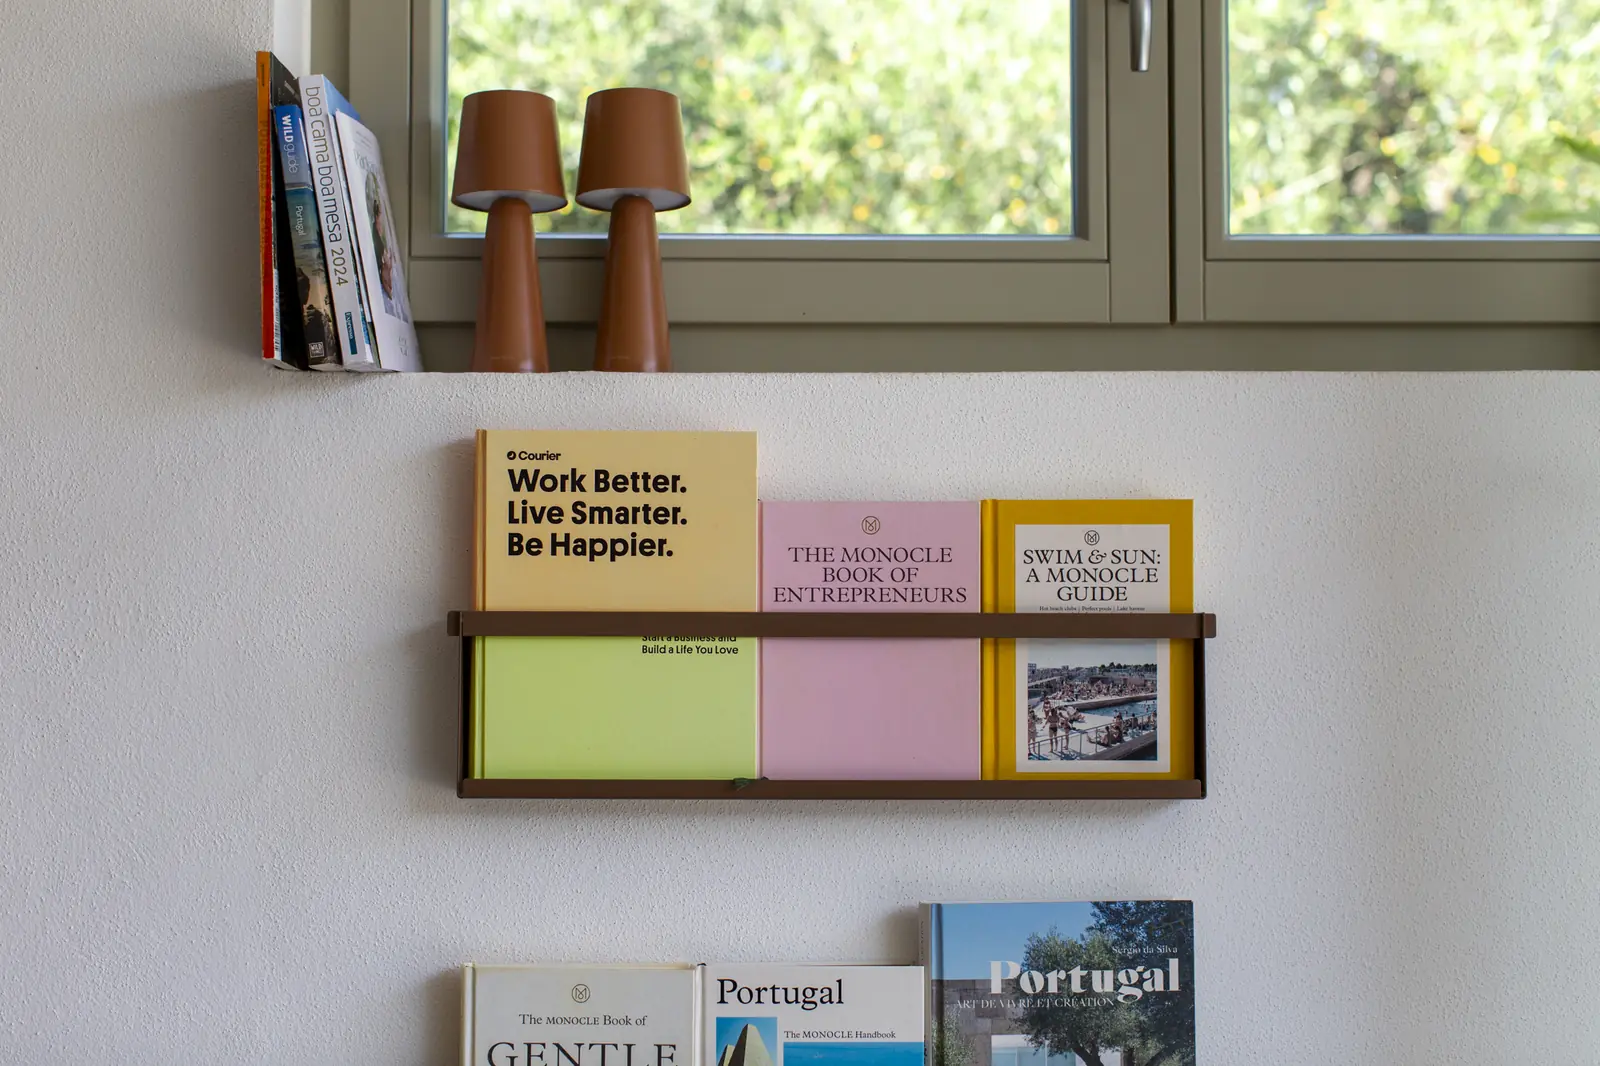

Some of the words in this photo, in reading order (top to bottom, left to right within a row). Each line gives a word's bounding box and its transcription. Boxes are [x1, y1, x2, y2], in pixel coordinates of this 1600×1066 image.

[306, 86, 323, 117] boa
[311, 119, 330, 164] cama
[317, 165, 335, 197] boa
[295, 205, 307, 236] Portugal
[323, 198, 343, 243] mesa
[331, 247, 349, 287] 2024
[518, 451, 561, 461] Courier
[507, 468, 586, 493] Work
[594, 469, 687, 493] Better.
[507, 500, 564, 524] Live
[571, 501, 687, 525] Smarter.
[507, 533, 543, 556] Be
[550, 532, 673, 562] Happier.
[788, 547, 835, 563] THE
[840, 547, 953, 563] MONOCLE
[1023, 549, 1084, 565] SWIM
[1088, 549, 1107, 565] &
[1110, 549, 1161, 565] SUN:
[822, 567, 884, 583] BOOK
[890, 567, 919, 583] OF
[1026, 567, 1040, 583] A
[1046, 567, 1158, 583] MONOCLE
[773, 587, 967, 603] ENTREPRENEURS
[1057, 586, 1128, 601] GUIDE
[642, 645, 667, 654] Build
[676, 645, 693, 654] Life
[695, 645, 713, 654] You
[715, 645, 739, 654] Love
[1112, 945, 1140, 959] Sergio
[1143, 946, 1154, 954] da
[1156, 945, 1178, 954] Silva
[989, 957, 1181, 1003] Portugal
[716, 978, 844, 1011] Portugal
[956, 999, 977, 1009] ART
[981, 999, 997, 1009] DE
[999, 999, 1033, 1009] VIVRE
[1037, 999, 1051, 1009] ET
[518, 1014, 543, 1025] The
[546, 1016, 600, 1026] MONOCLE
[603, 1015, 632, 1026] Book
[635, 1015, 648, 1026] of
[783, 1031, 801, 1040] The
[802, 1031, 854, 1040] MONOCLE
[855, 1031, 897, 1040] Handbook
[486, 1041, 678, 1066] GENTLE
